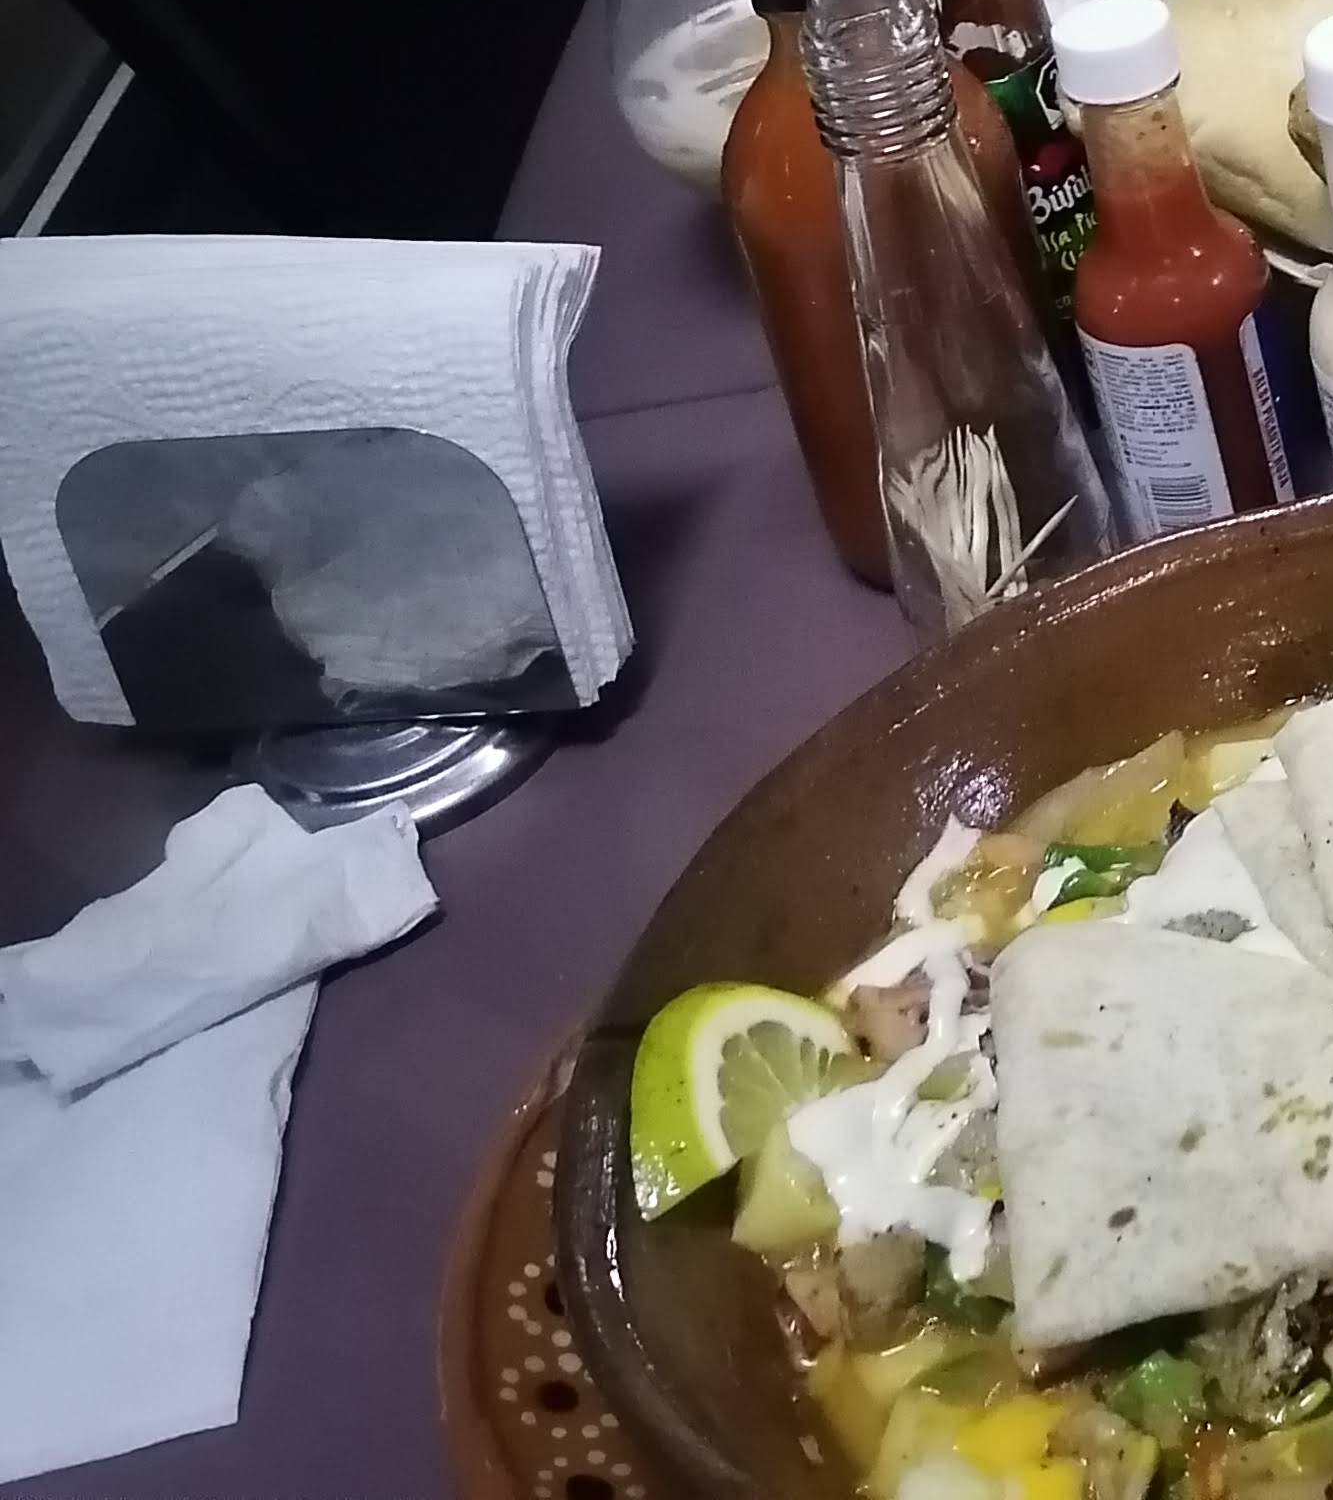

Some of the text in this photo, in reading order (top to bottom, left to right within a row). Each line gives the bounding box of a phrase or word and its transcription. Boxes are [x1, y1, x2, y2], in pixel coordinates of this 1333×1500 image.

[1028, 165, 1092, 224] Búfal
[1074, 211, 1099, 236] Pic
[1252, 367, 1290, 489] SALSA PICANTE ROJA
